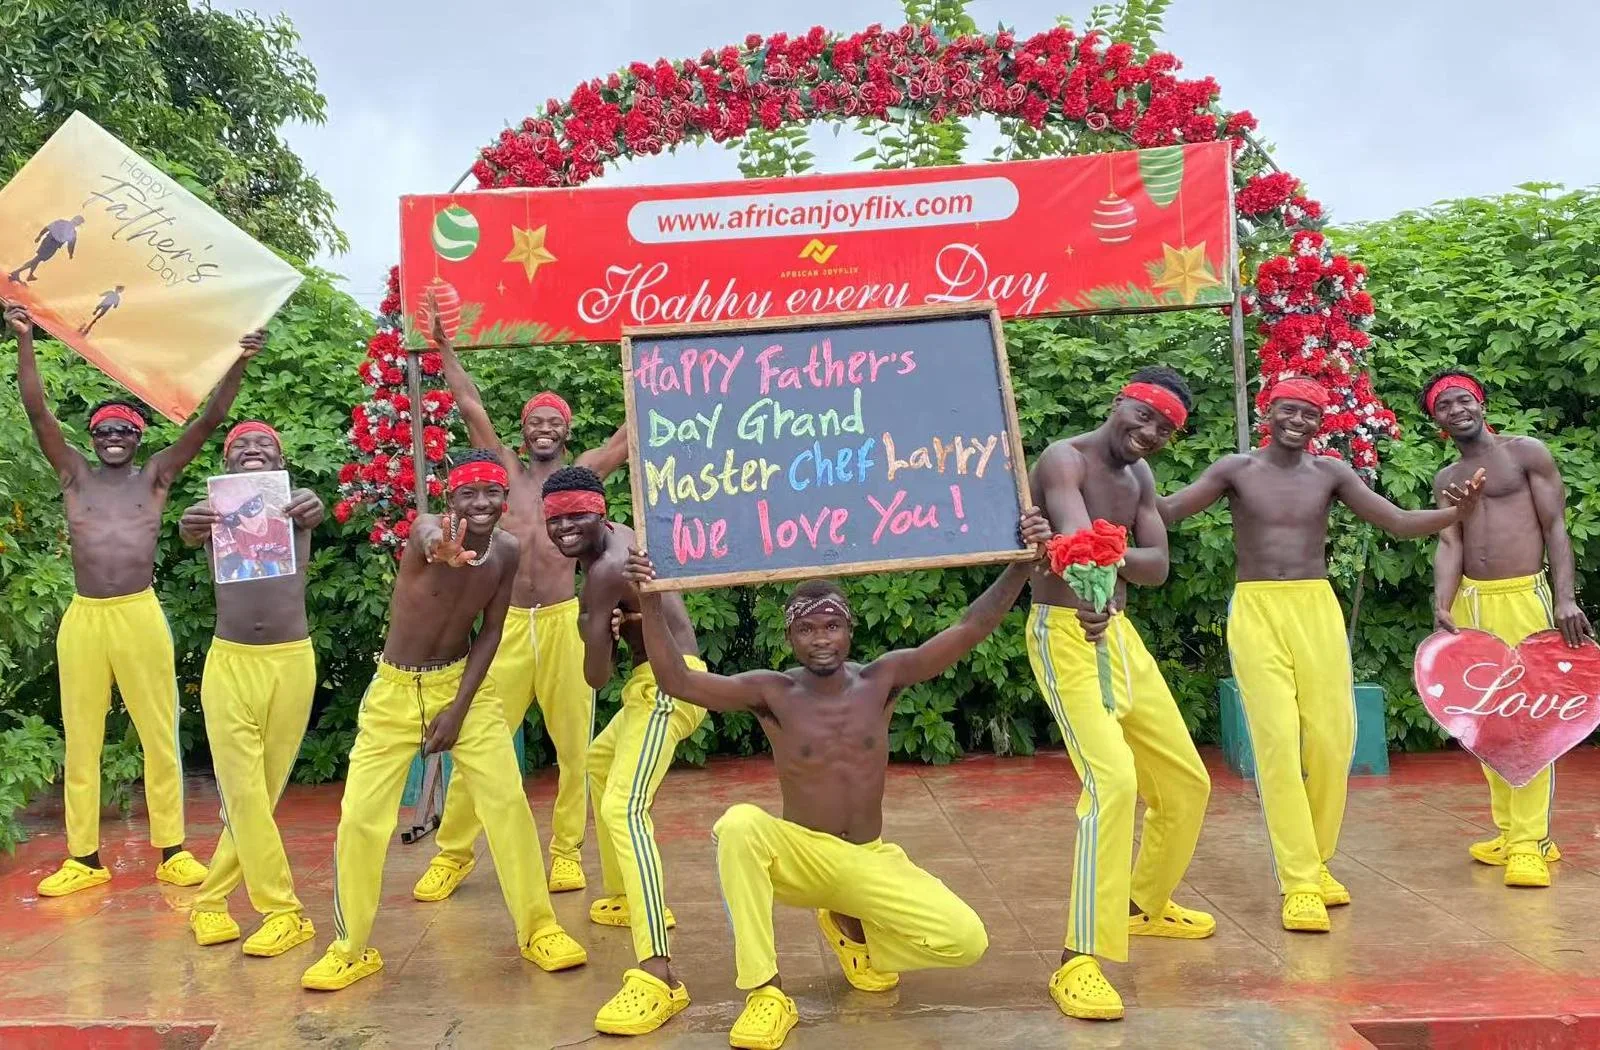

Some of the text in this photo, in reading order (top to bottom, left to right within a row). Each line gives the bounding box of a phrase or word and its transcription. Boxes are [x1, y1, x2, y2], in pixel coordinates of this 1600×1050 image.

[120, 157, 173, 200] Happy
[82, 175, 221, 283] Father's
[657, 191, 973, 233] www.africanjoyflix.com
[146, 254, 185, 287] Day
[577, 242, 1049, 326] Happy every Day
[780, 266, 859, 279] AFRICAN JOYFLIX
[755, 337, 917, 395] Father's
[737, 387, 865, 445] Grand
[645, 448, 781, 507] Master
[788, 436, 877, 491] Chef
[672, 512, 729, 566] We
[1443, 662, 1588, 721] Love
